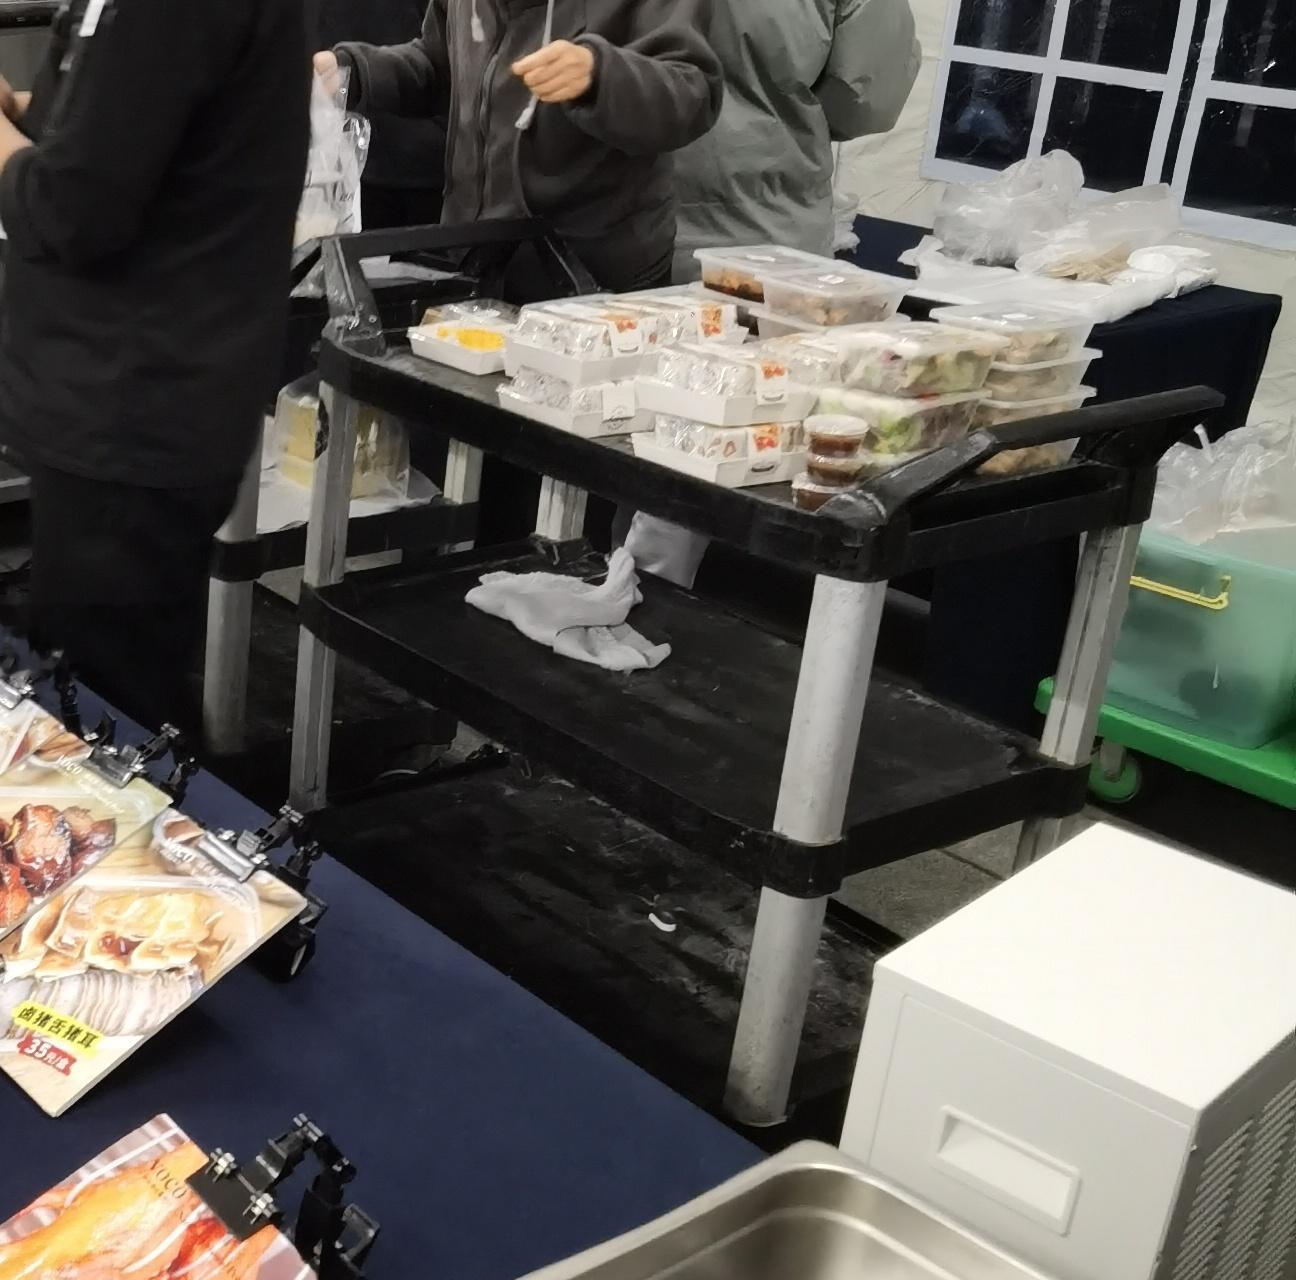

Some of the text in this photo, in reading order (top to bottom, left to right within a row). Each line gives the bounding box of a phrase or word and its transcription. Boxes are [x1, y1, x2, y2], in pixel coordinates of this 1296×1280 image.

[17, 1006, 99, 1048] 卤猪舌猪耳
[24, 1037, 71, 1073] 35元/盒
